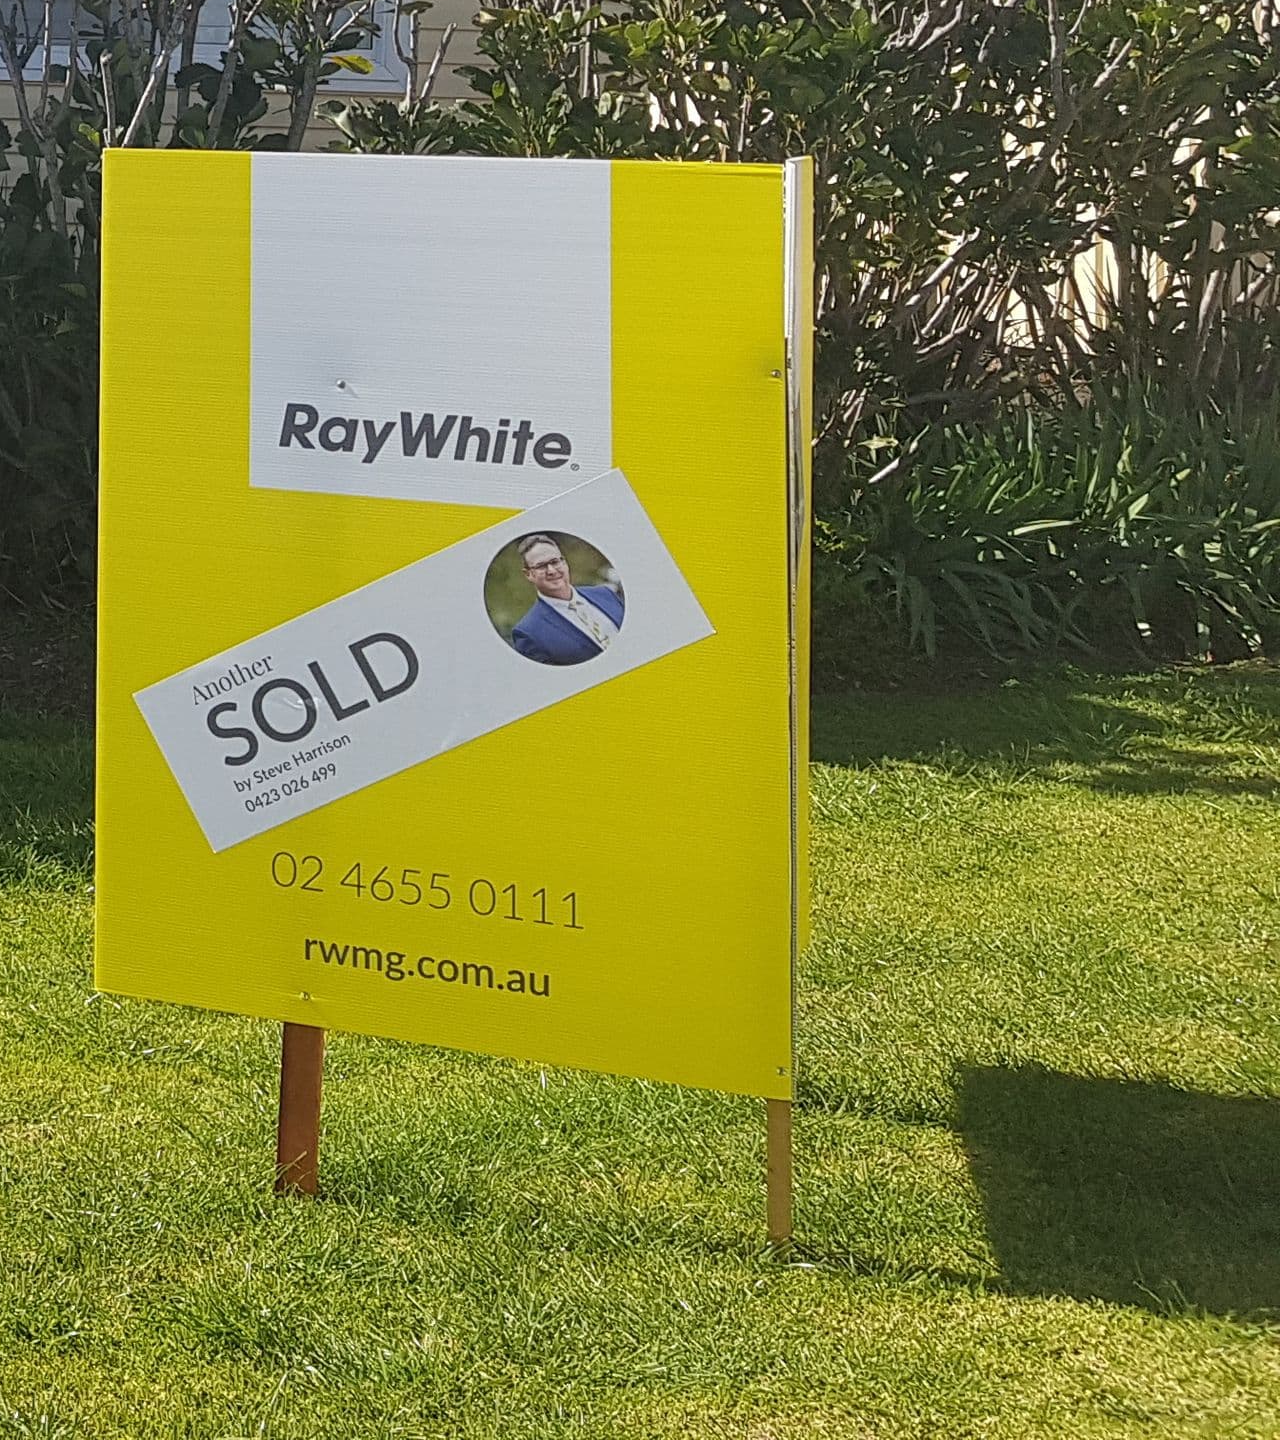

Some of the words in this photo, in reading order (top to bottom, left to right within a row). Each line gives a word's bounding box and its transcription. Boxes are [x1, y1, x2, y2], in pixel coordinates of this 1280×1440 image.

[192, 655, 274, 706] Another
[206, 632, 420, 767] SOLD
[233, 779, 253, 793] by
[253, 760, 293, 784] Steve
[292, 733, 352, 767] Harrison
[244, 787, 281, 813] 0423
[281, 778, 310, 797] 026
[311, 763, 338, 784] 499
[271, 851, 324, 893] 02
[340, 862, 452, 910] 4655
[469, 879, 585, 930] 0111
[304, 937, 551, 998] rwmg.com.au
